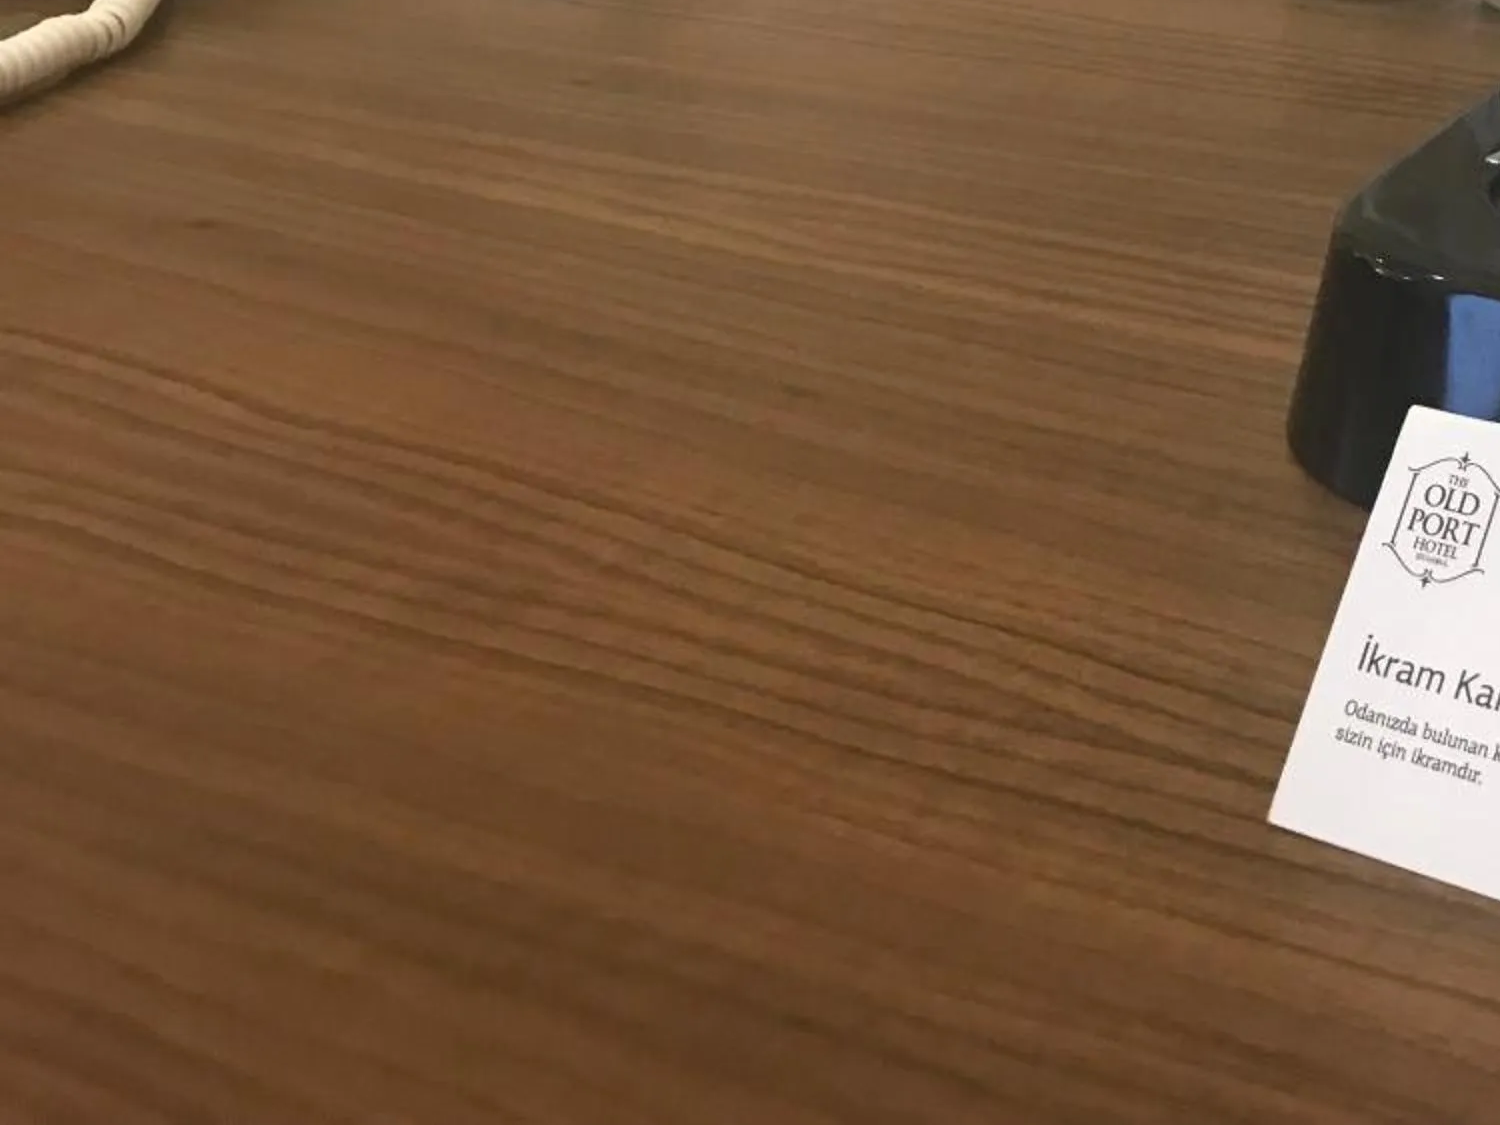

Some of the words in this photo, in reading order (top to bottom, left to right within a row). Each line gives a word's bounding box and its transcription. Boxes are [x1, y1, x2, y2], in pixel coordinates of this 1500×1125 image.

[1448, 473, 1470, 488] THE
[1424, 484, 1481, 516] OLD
[1407, 507, 1481, 546] PORT
[1413, 536, 1457, 559] HOTEL
[1356, 633, 1446, 695] İkram
[1335, 726, 1373, 750] sizin
[1377, 739, 1407, 762] için
[1343, 698, 1418, 737] Odanızda
[1422, 721, 1489, 759] bulunan
